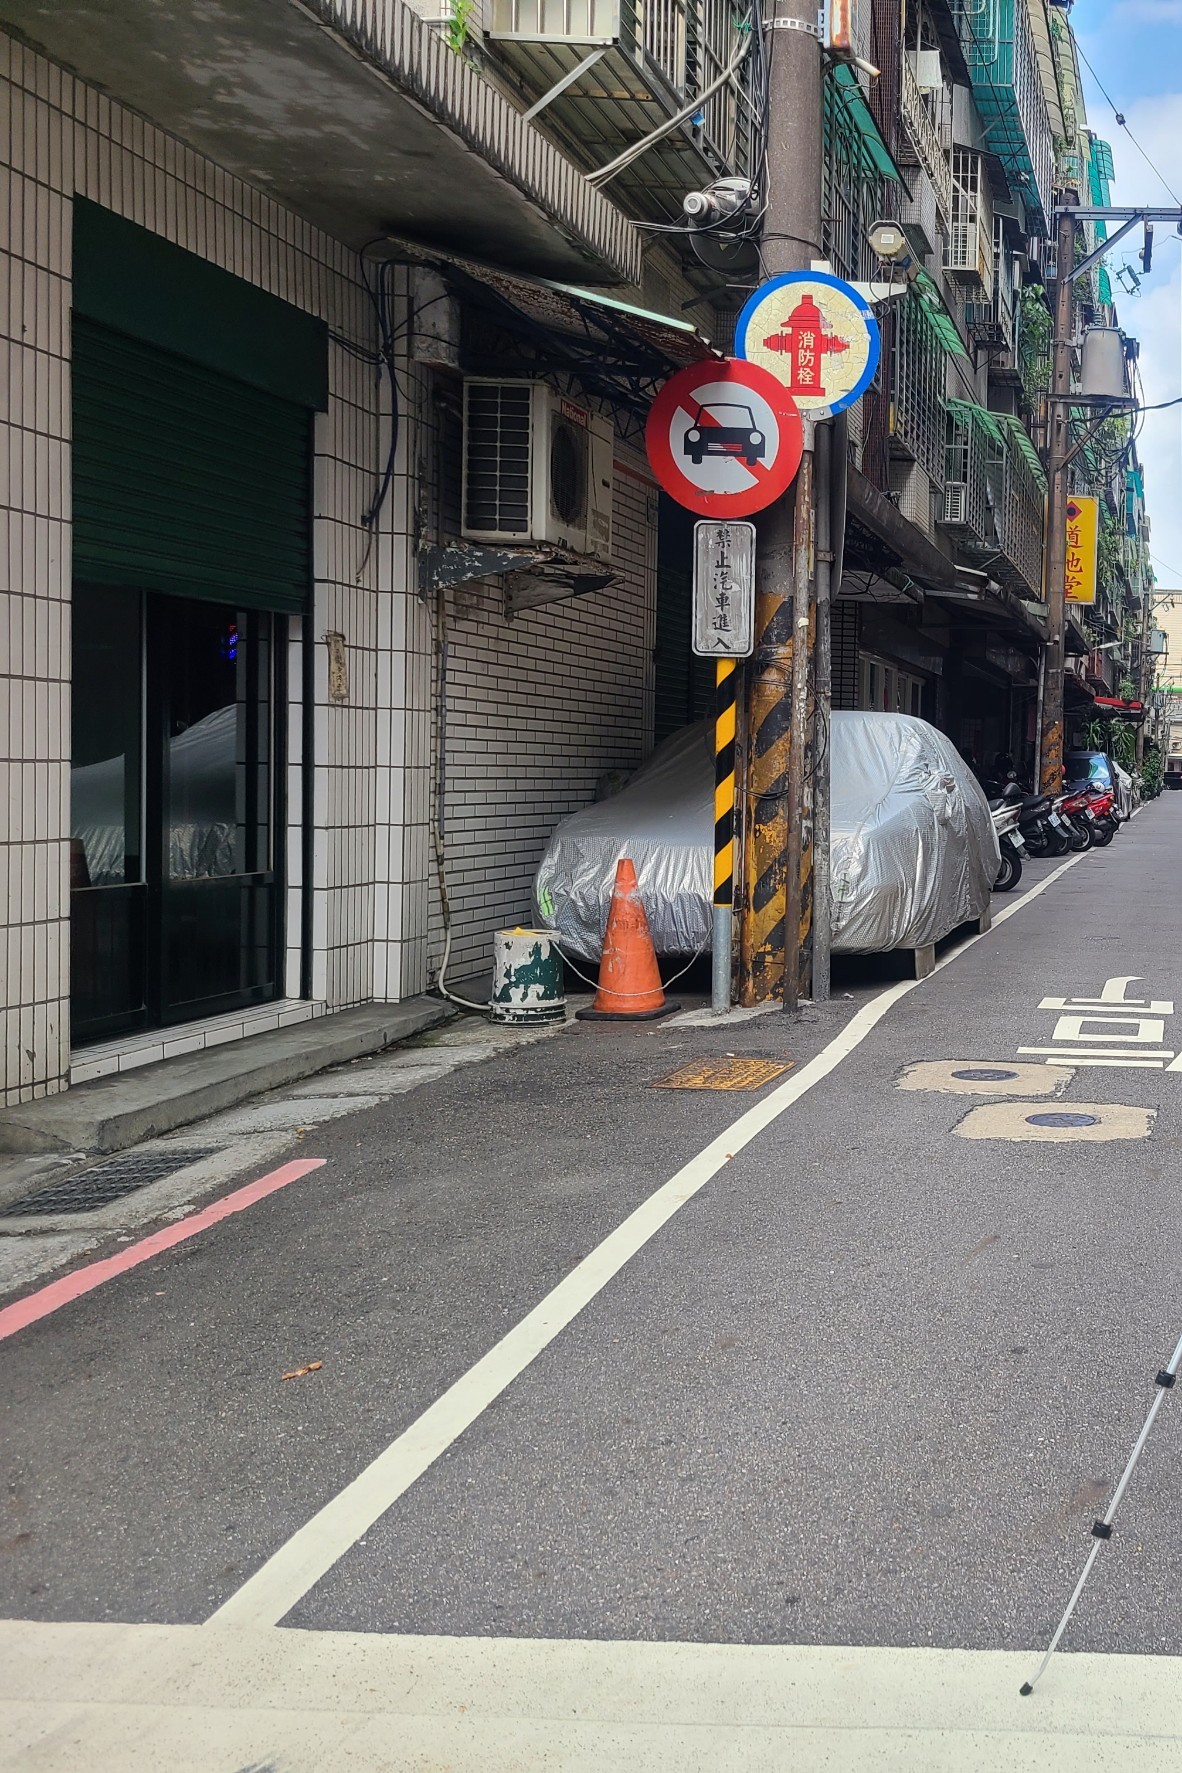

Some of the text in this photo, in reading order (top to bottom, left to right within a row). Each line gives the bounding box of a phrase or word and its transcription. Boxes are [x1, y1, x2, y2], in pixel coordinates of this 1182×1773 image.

[797, 330, 816, 385] 消防栓
[561, 399, 588, 428] National
[711, 528, 733, 650] 禁止汽車進入
